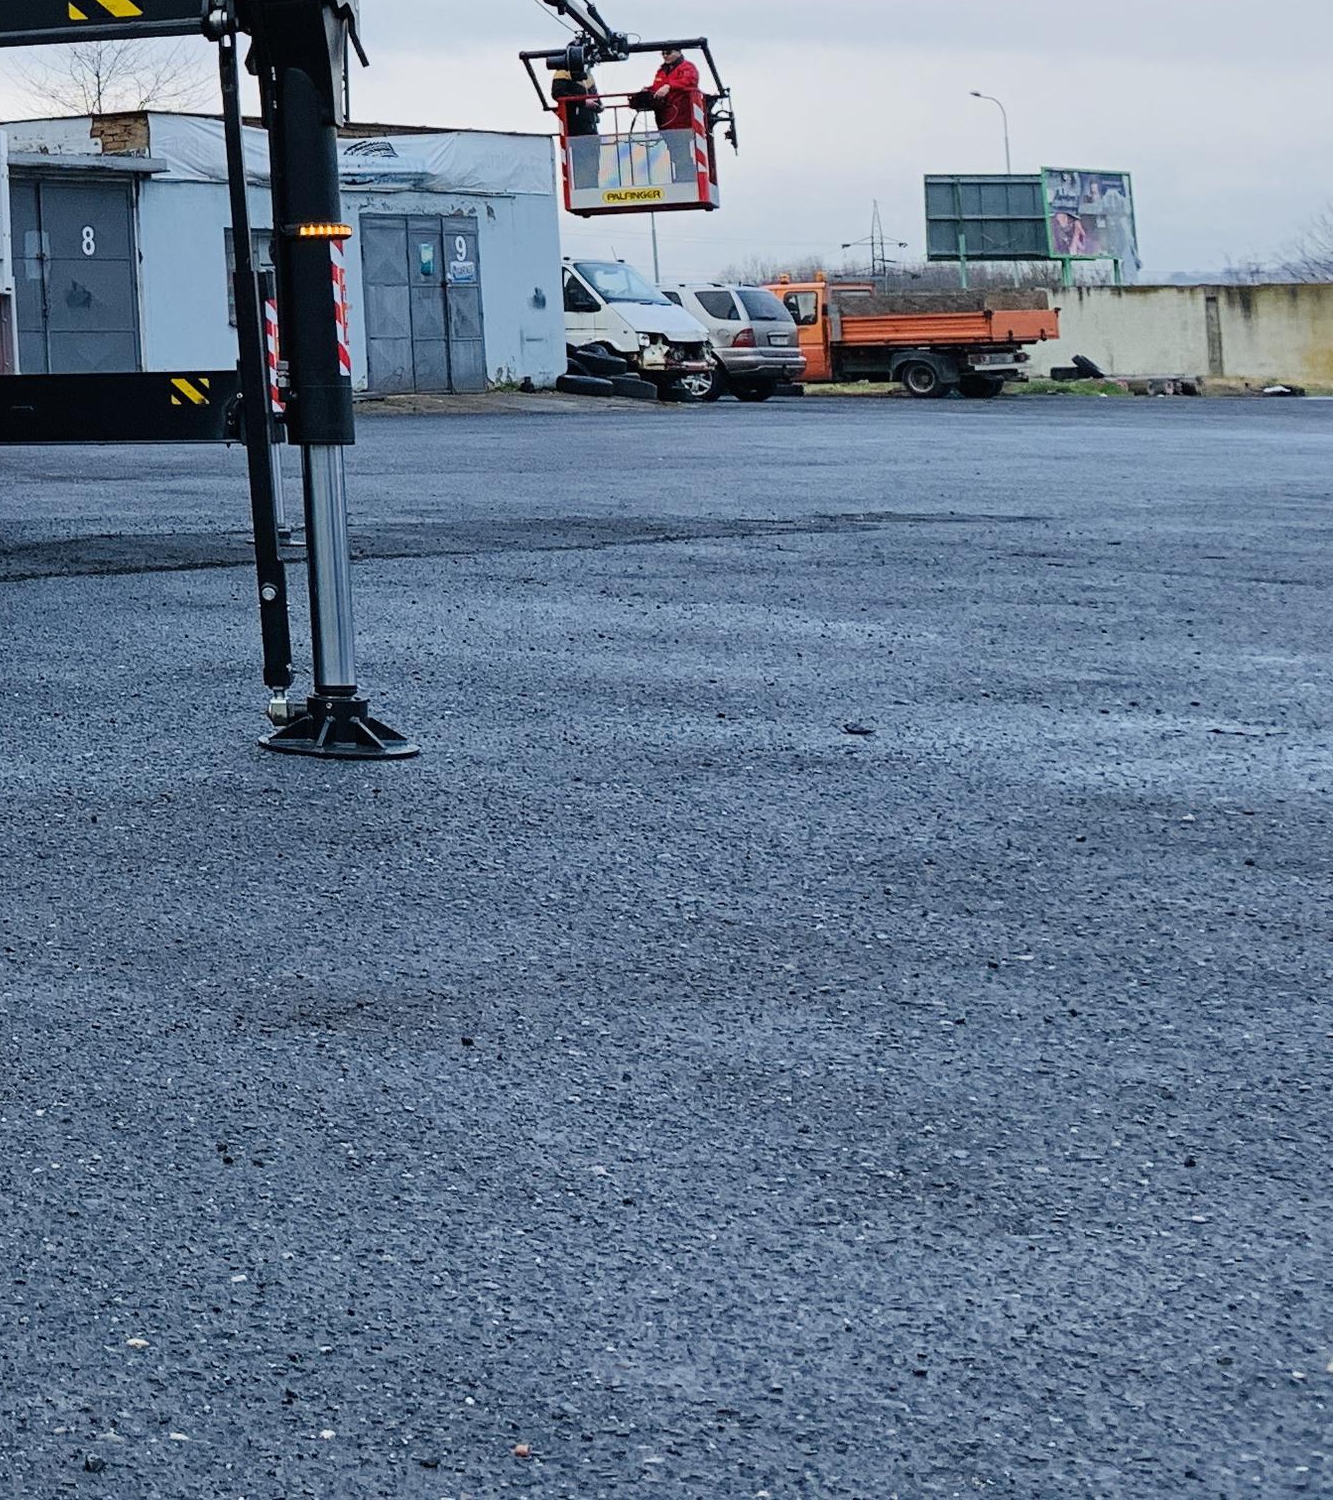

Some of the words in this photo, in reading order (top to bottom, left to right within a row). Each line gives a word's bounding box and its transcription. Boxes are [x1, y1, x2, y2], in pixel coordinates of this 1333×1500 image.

[606, 189, 662, 201] PALFINGER
[82, 226, 96, 256] 8
[454, 235, 467, 261] 9
